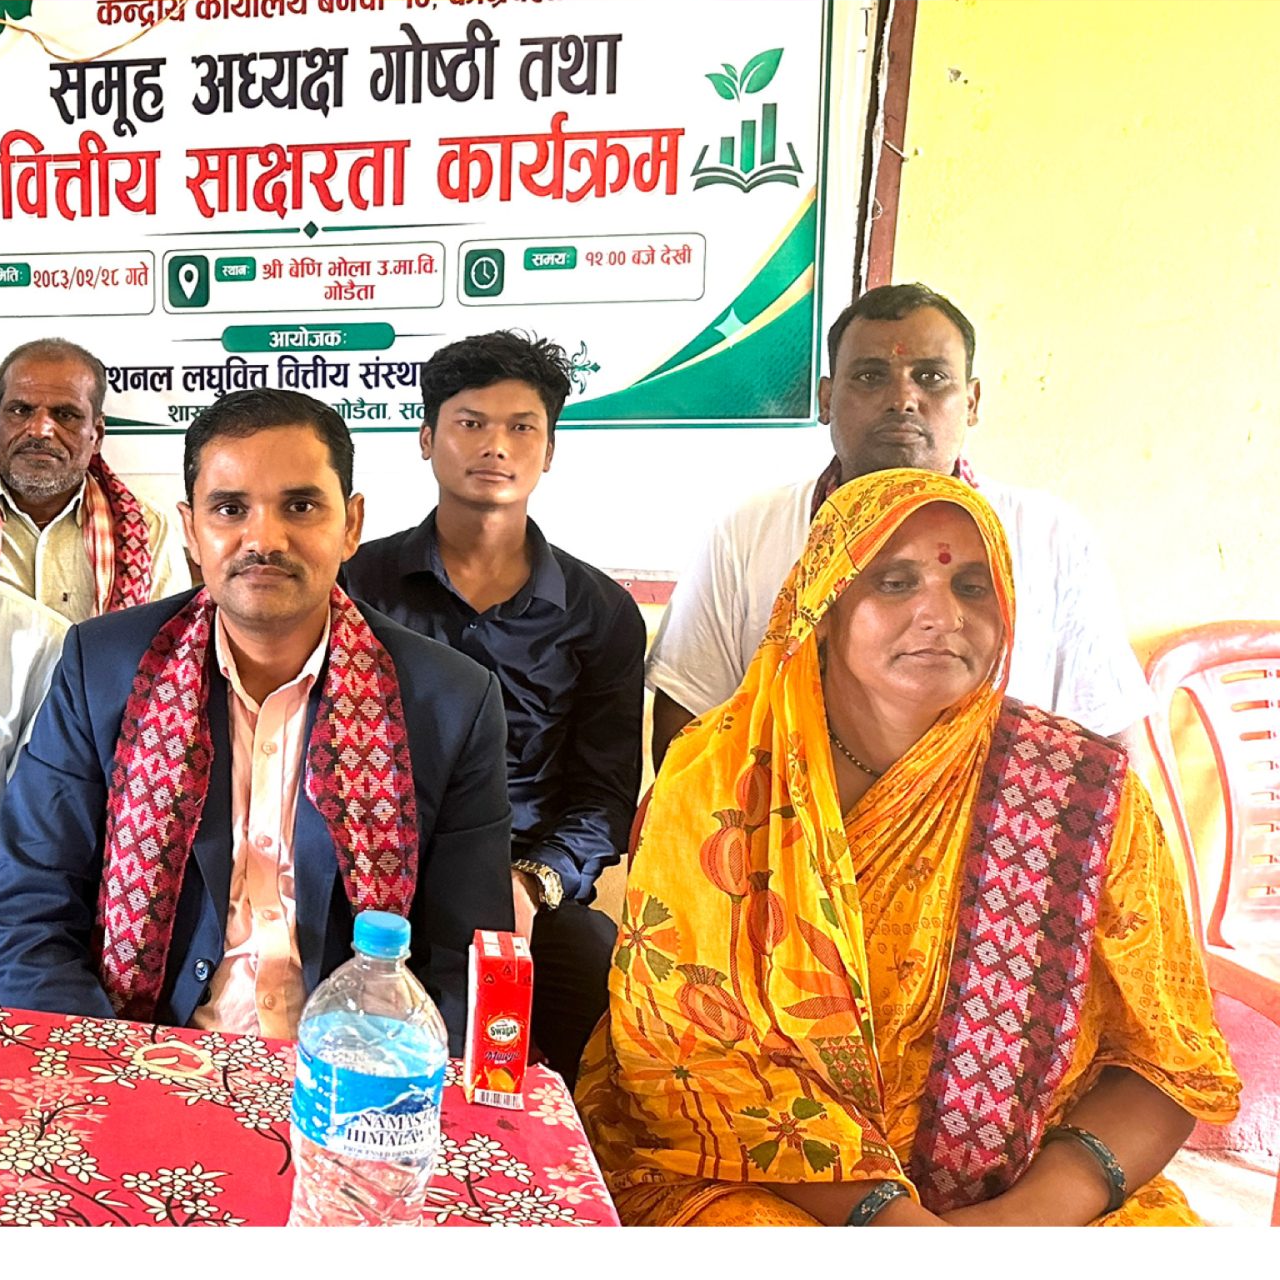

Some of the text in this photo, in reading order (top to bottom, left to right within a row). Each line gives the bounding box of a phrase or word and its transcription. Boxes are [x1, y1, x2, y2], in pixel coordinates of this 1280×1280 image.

[50, 19, 622, 137] समूह अध्यक्ष गोष्ठी तथा
[0, 111, 685, 220] वित्तीय साक्षरता कार्यक्रम
[632, 245, 656, 265] बजे
[661, 244, 692, 265] देखी
[125, 261, 149, 286] गते
[262, 258, 284, 280] श्री
[328, 256, 372, 277] भोला
[324, 280, 375, 301] गोडैता
[105, 365, 174, 393] शनल
[182, 356, 269, 397] लघुवित्त
[277, 355, 350, 390] वित्तीय
